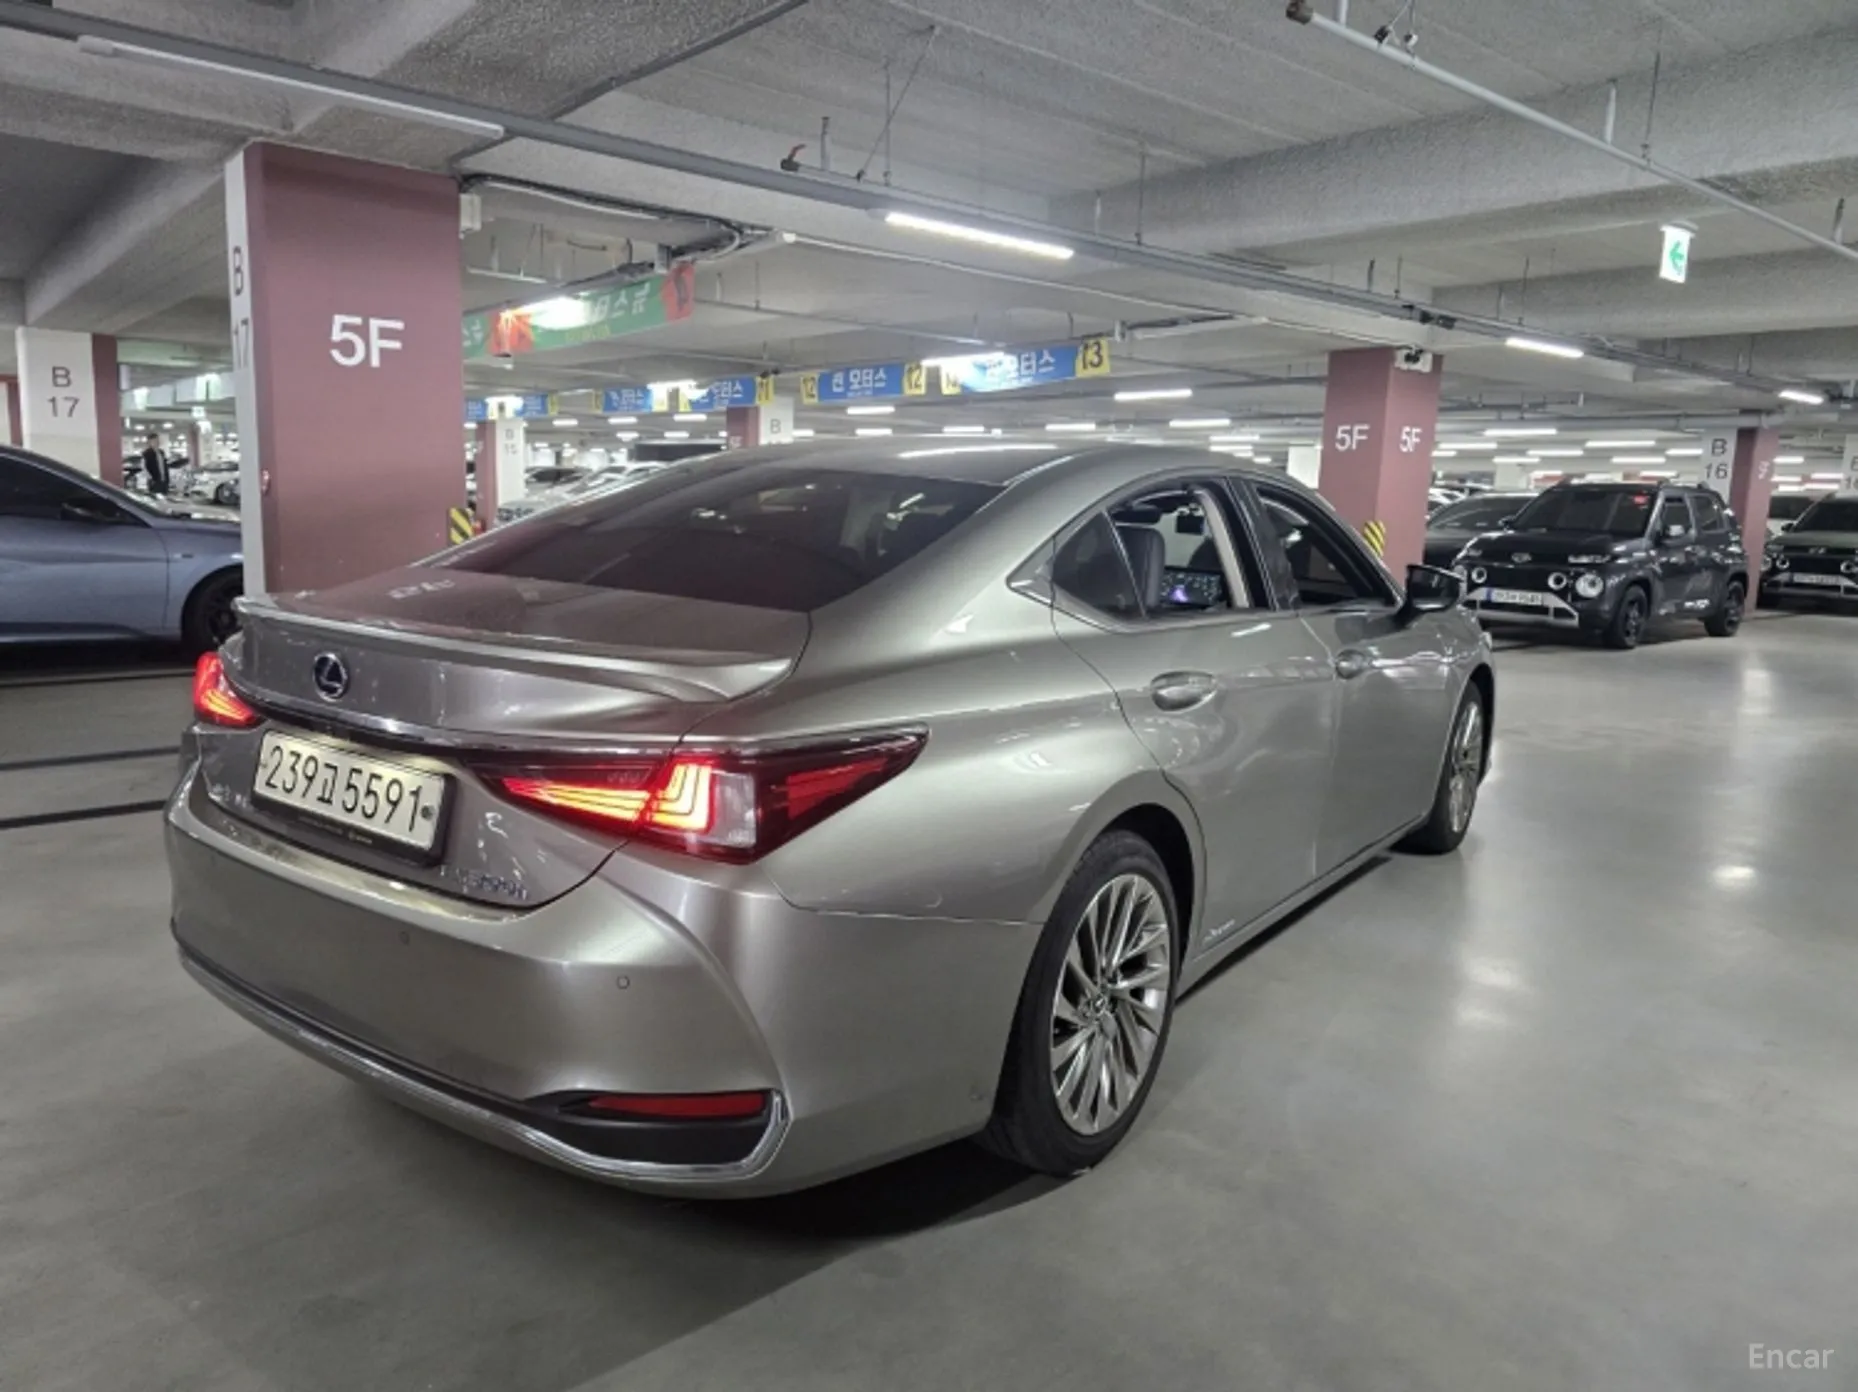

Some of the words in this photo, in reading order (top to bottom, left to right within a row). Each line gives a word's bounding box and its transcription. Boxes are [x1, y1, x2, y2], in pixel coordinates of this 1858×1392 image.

[233, 245, 244, 296] B
[233, 317, 249, 370] 17
[330, 314, 405, 368] 5F
[1082, 341, 1104, 370] 13
[52, 366, 72, 388] B
[47, 396, 80, 418] 17
[770, 418, 782, 435] B
[1335, 423, 1371, 452] 5F
[1399, 426, 1423, 453] 5F
[1711, 438, 1728, 457] B
[1704, 462, 1729, 480] 16
